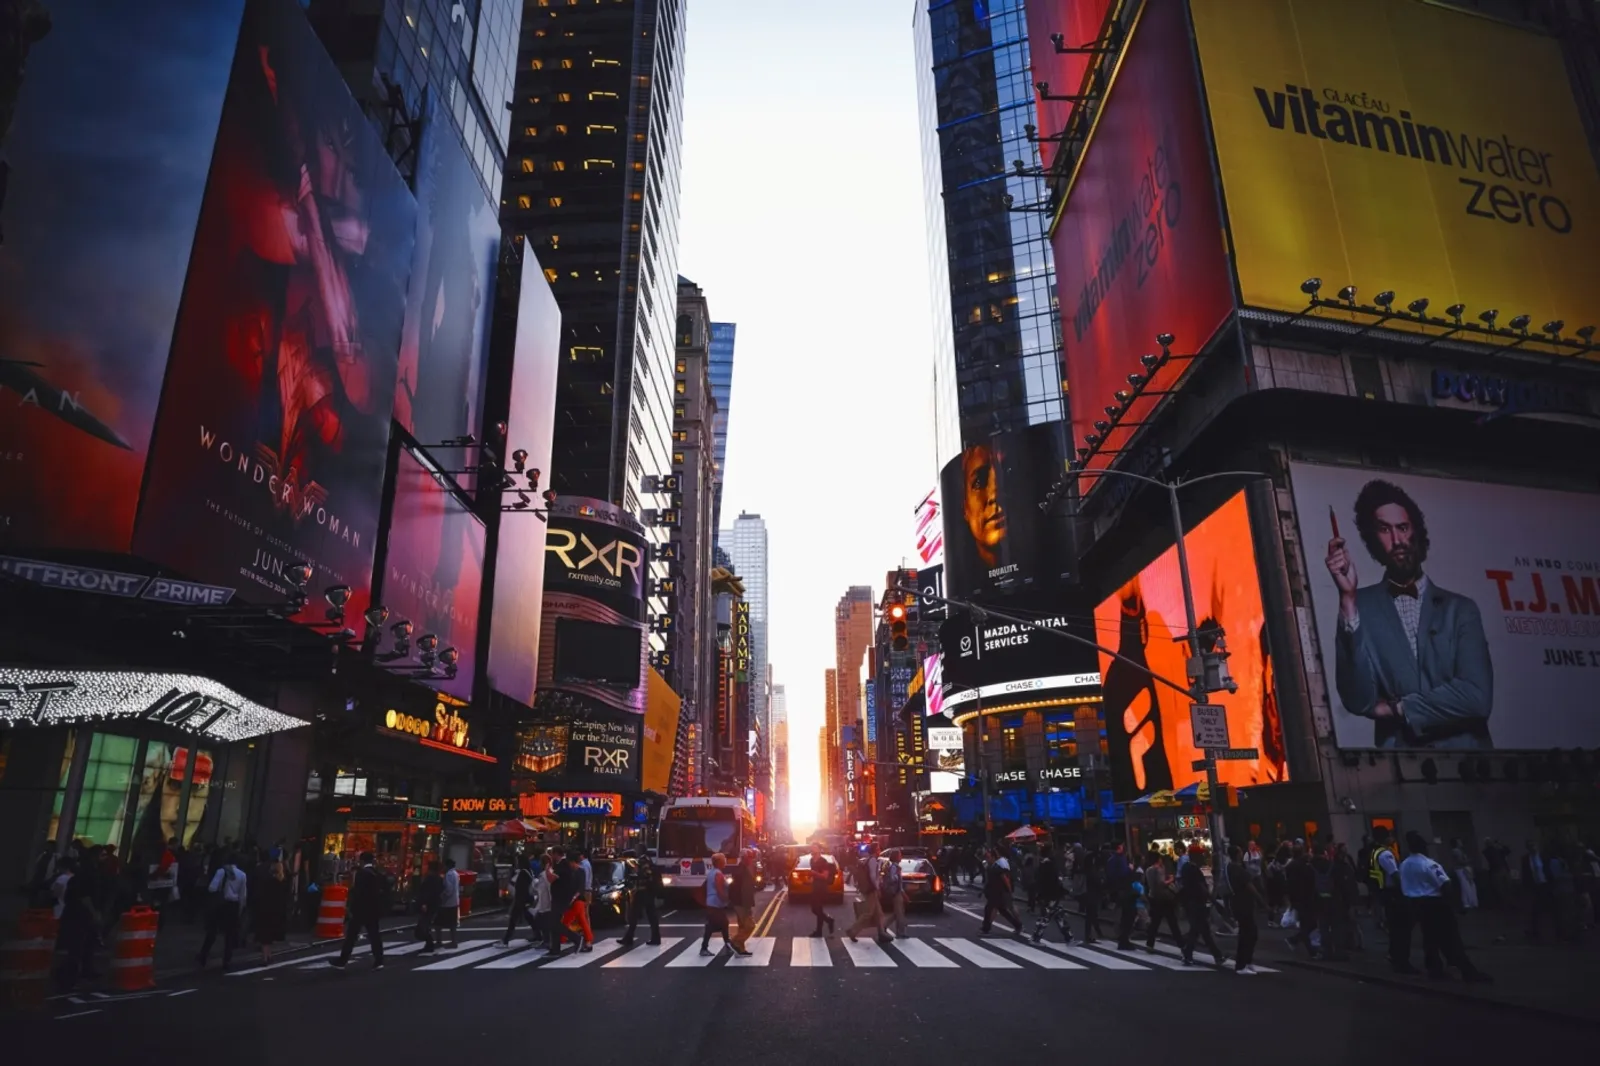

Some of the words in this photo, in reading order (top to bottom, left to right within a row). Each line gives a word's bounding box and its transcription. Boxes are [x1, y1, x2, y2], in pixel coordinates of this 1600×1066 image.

[1254, 85, 1553, 187] vitaminwater
[1459, 177, 1572, 234] zero
[1134, 181, 1182, 288] zero
[200, 425, 290, 503] WONDER
[303, 496, 361, 548] WOMAN
[224, 509, 251, 531] FUTURE
[252, 548, 284, 578] JUN
[545, 527, 640, 585] RXR
[1514, 556, 1531, 567] AN
[1534, 558, 1562, 569] HBO
[568, 571, 621, 588] rxrrealty.com
[662, 478, 676, 667] CHAMPS
[154, 581, 225, 605] PRIME
[392, 566, 438, 608] WONDER
[1561, 575, 1600, 616] M
[737, 602, 749, 670] MADAME
[984, 624, 1018, 639] MAZDA
[984, 634, 1029, 651] SERVICES
[1543, 648, 1587, 667] JUNE
[1005, 681, 1034, 691] CHASE
[147, 687, 241, 733] LOFT
[1197, 707, 1219, 716] BUSES
[608, 722, 623, 733] New
[624, 723, 635, 734] York
[913, 714, 923, 751] VICTORY
[572, 732, 585, 741] for
[587, 732, 600, 742] the
[615, 735, 636, 748] Century
[584, 747, 629, 769] RXR
[593, 766, 623, 775] REALTY
[846, 750, 855, 802] REGAL
[995, 771, 1026, 782] CHASE
[1039, 768, 1081, 779] CHASE
[452, 798, 486, 811] KNOW
[548, 797, 614, 813] CHAMPS
